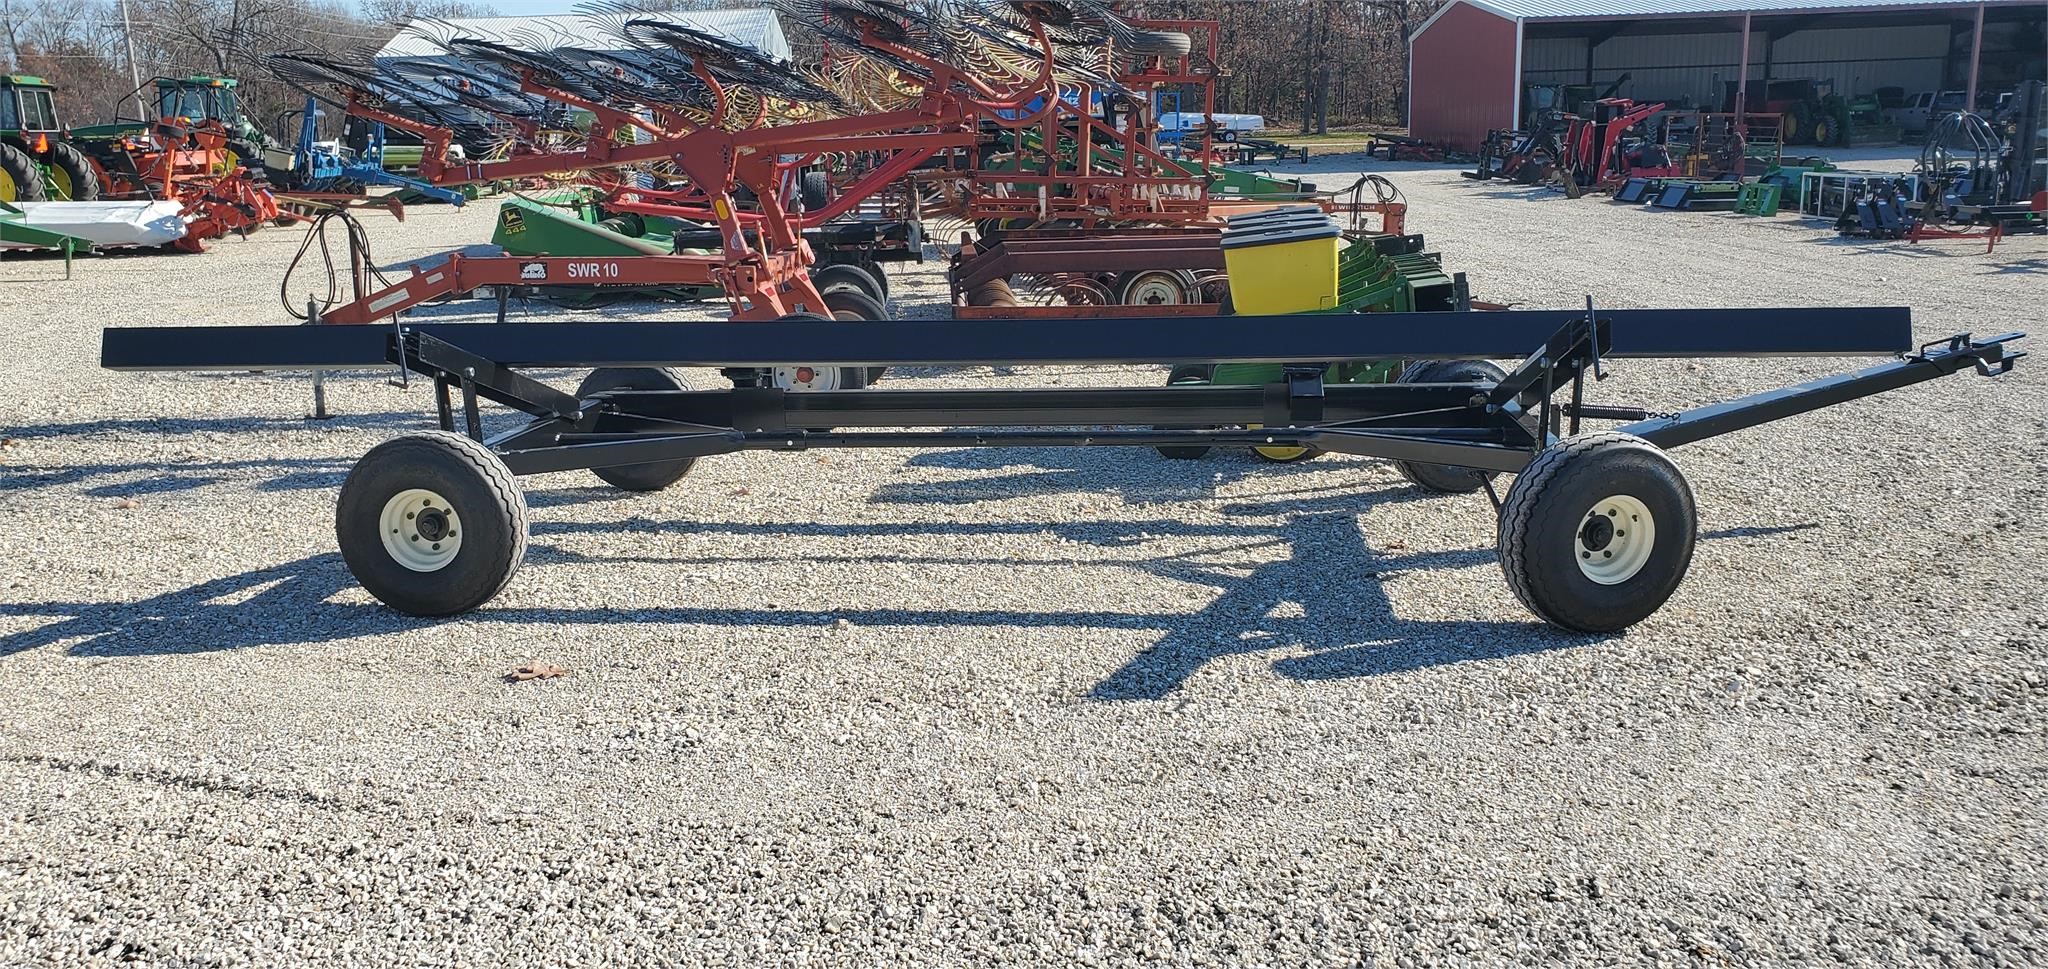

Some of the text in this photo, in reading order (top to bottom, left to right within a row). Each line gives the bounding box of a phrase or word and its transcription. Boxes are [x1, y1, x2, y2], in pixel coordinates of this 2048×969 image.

[505, 225, 527, 235] 444
[568, 262, 618, 278] SWR 10
